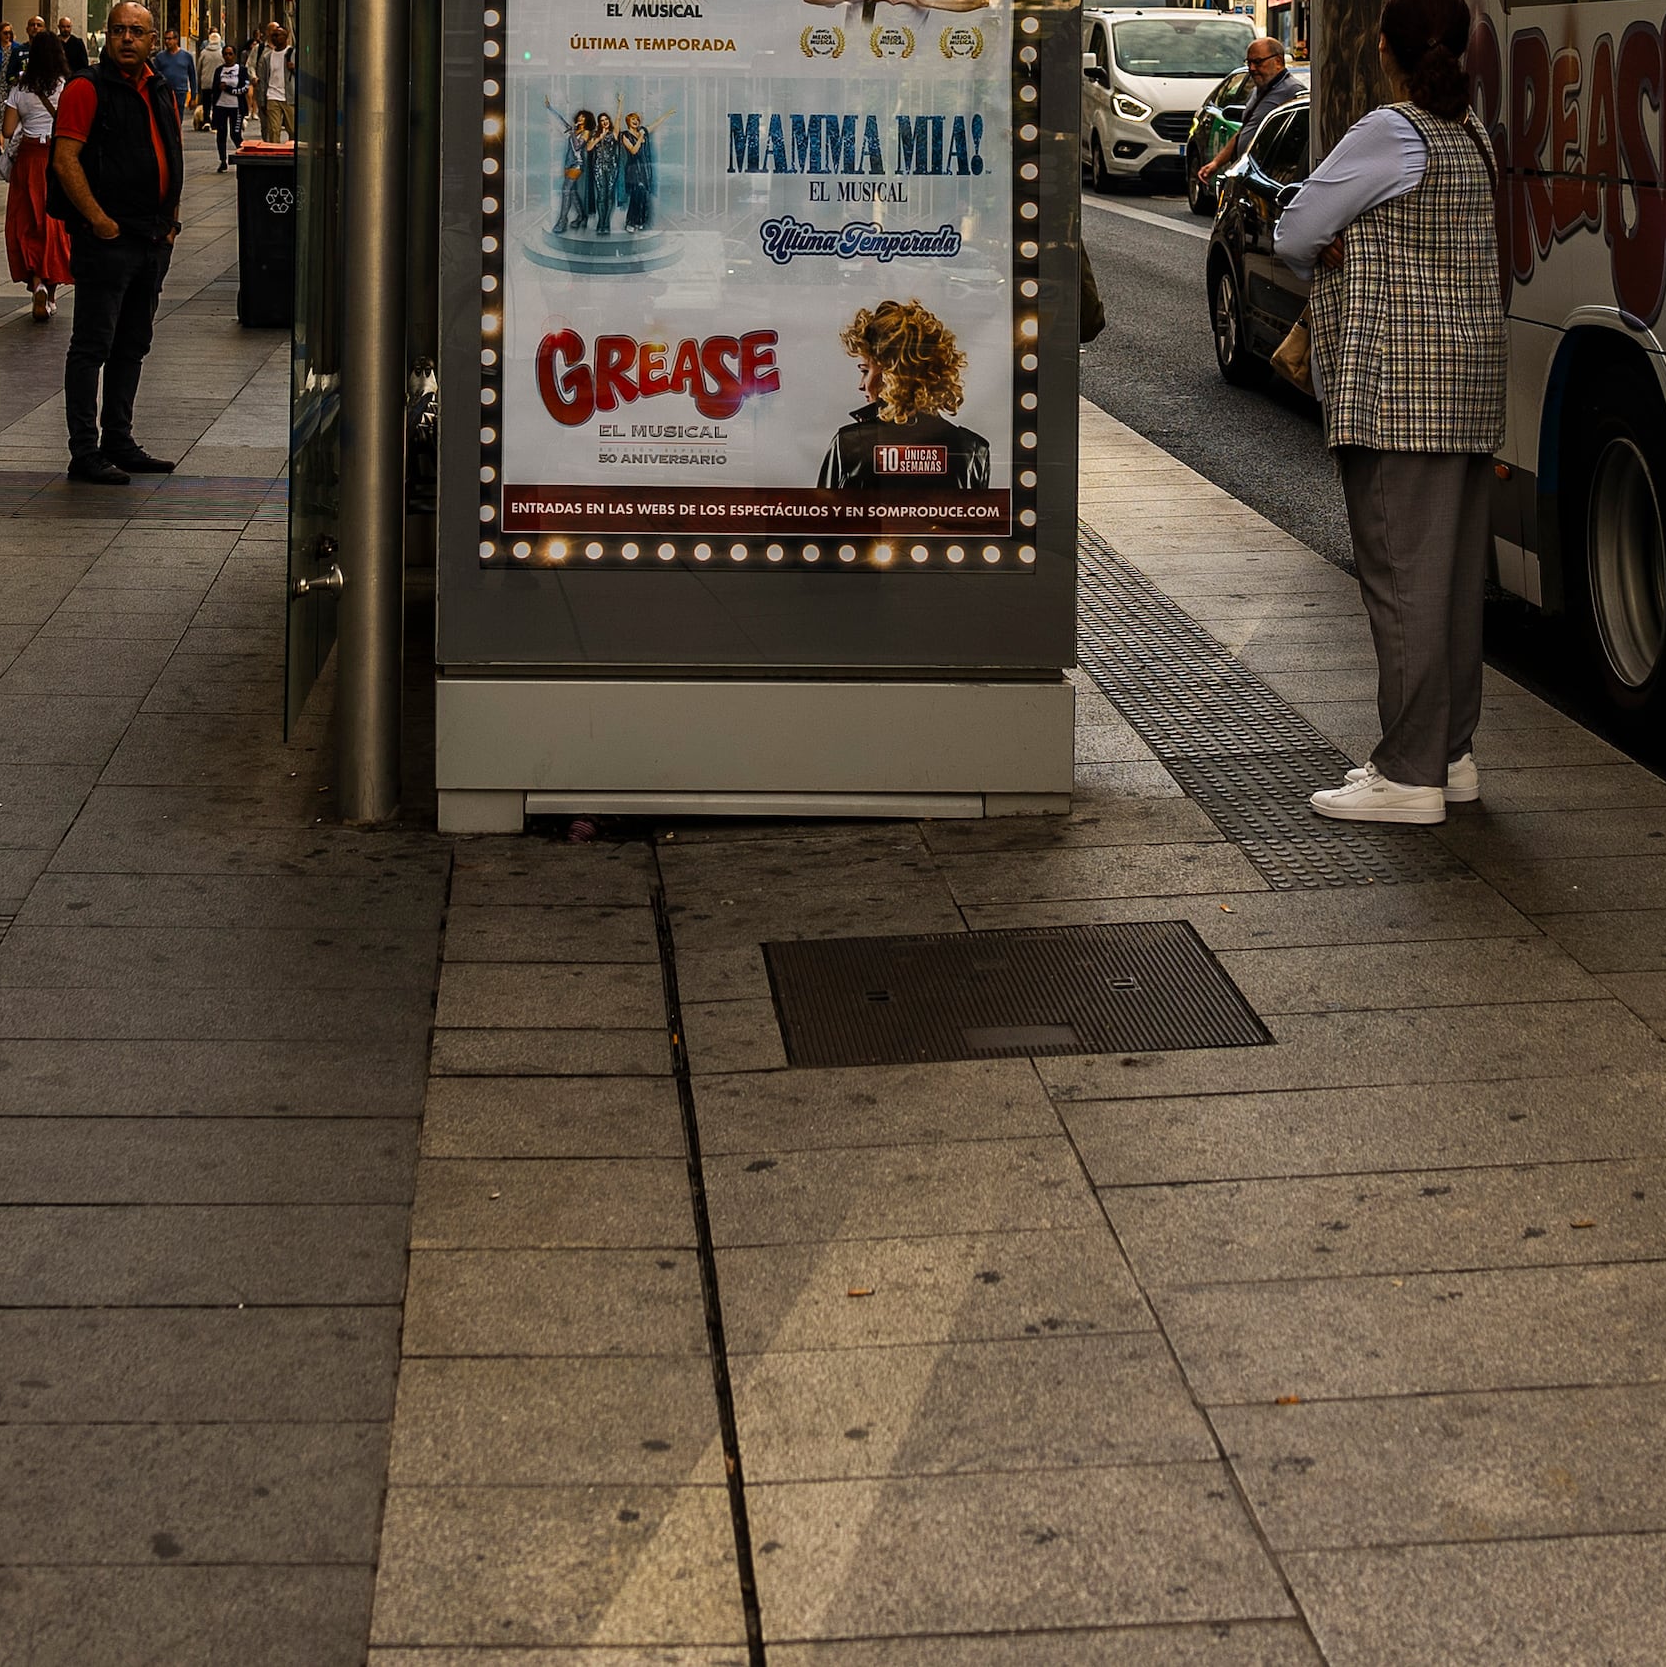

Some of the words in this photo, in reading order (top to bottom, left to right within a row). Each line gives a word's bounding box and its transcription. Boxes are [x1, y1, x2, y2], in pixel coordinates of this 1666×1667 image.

[606, 3, 623, 17] EL
[632, 3, 703, 18] MUSICAL
[569, 33, 630, 51] ÚLTIMA
[634, 37, 737, 52] TEMPORADA
[727, 113, 885, 175] MAMMA
[895, 114, 984, 176] MIA!
[809, 181, 830, 202] EL
[837, 181, 908, 203] MUSICAL
[762, 217, 838, 264] Última
[838, 221, 961, 262] Temporada
[535, 328, 782, 427] GREASE
[599, 425, 625, 437] EL
[631, 425, 728, 439] MUSICAL
[598, 454, 618, 464] 50
[621, 454, 727, 465] ANIVERSARIO
[879, 447, 899, 472] 10
[904, 446, 938, 461] ÚNICAS
[900, 460, 942, 472] SEMANAS
[511, 502, 582, 514] ENTRADAS
[586, 503, 605, 514] EN
[608, 503, 633, 515] LAS
[636, 504, 675, 515] WEBS
[679, 504, 696, 515] DE
[699, 504, 726, 516] LOS
[730, 502, 829, 517] ESPECTÁCULOS
[832, 506, 842, 517] Y
[845, 506, 864, 517] EN
[867, 506, 1000, 518] SOMPRODUCE.COM
